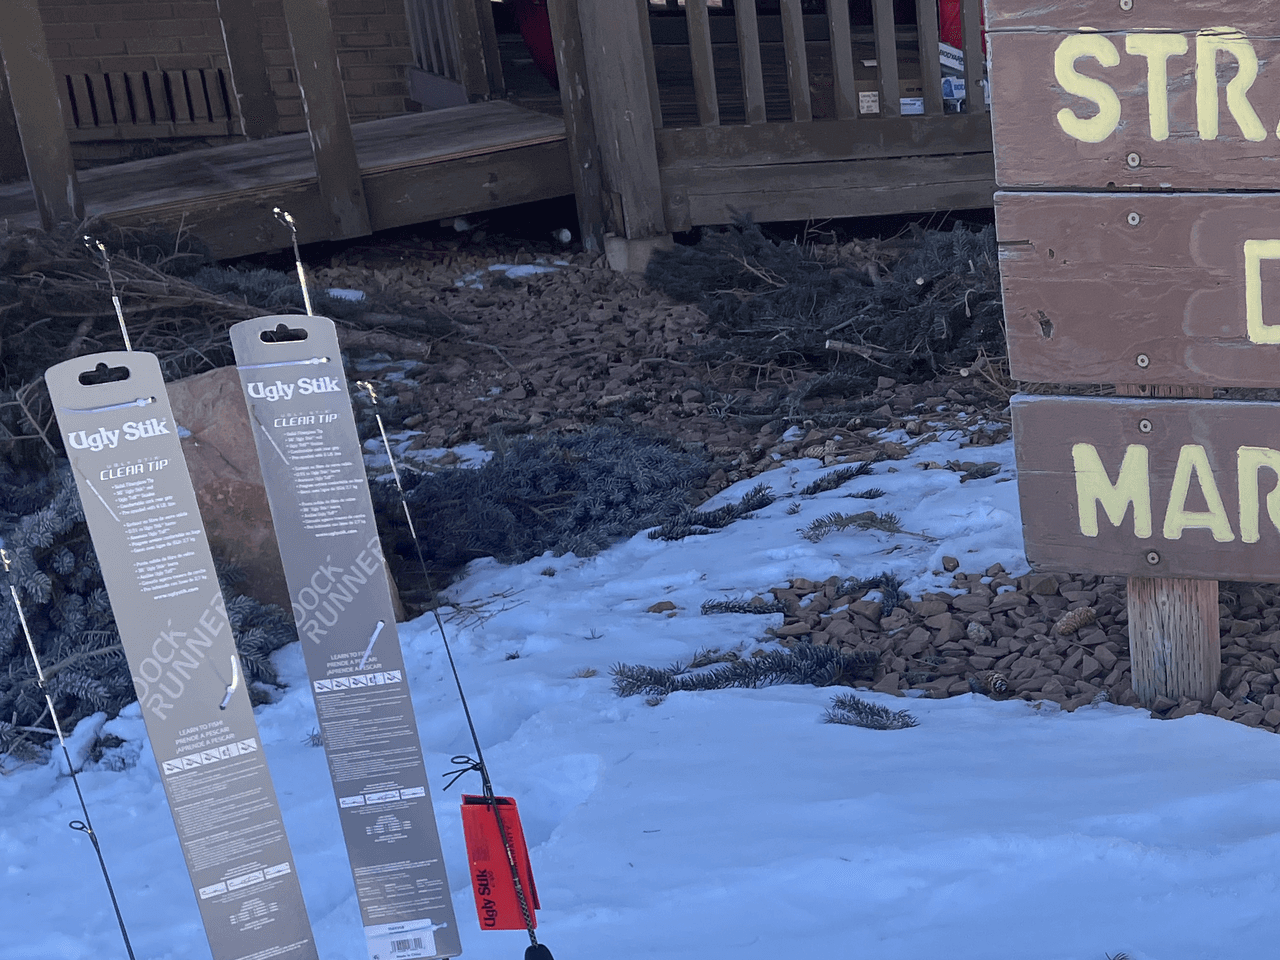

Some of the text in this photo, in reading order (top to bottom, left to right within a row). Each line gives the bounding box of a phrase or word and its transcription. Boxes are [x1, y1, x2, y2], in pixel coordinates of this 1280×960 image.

[247, 376, 341, 401] Ugly Stik
[274, 412, 338, 428] CLEAR TIP
[67, 418, 170, 452] Ugly Stik
[100, 458, 169, 481] CLEAR TIP
[302, 536, 386, 644] RUNNER
[179, 727, 199, 736] LEARN
[475, 868, 490, 896] Stik
[480, 897, 498, 927] Ugly
